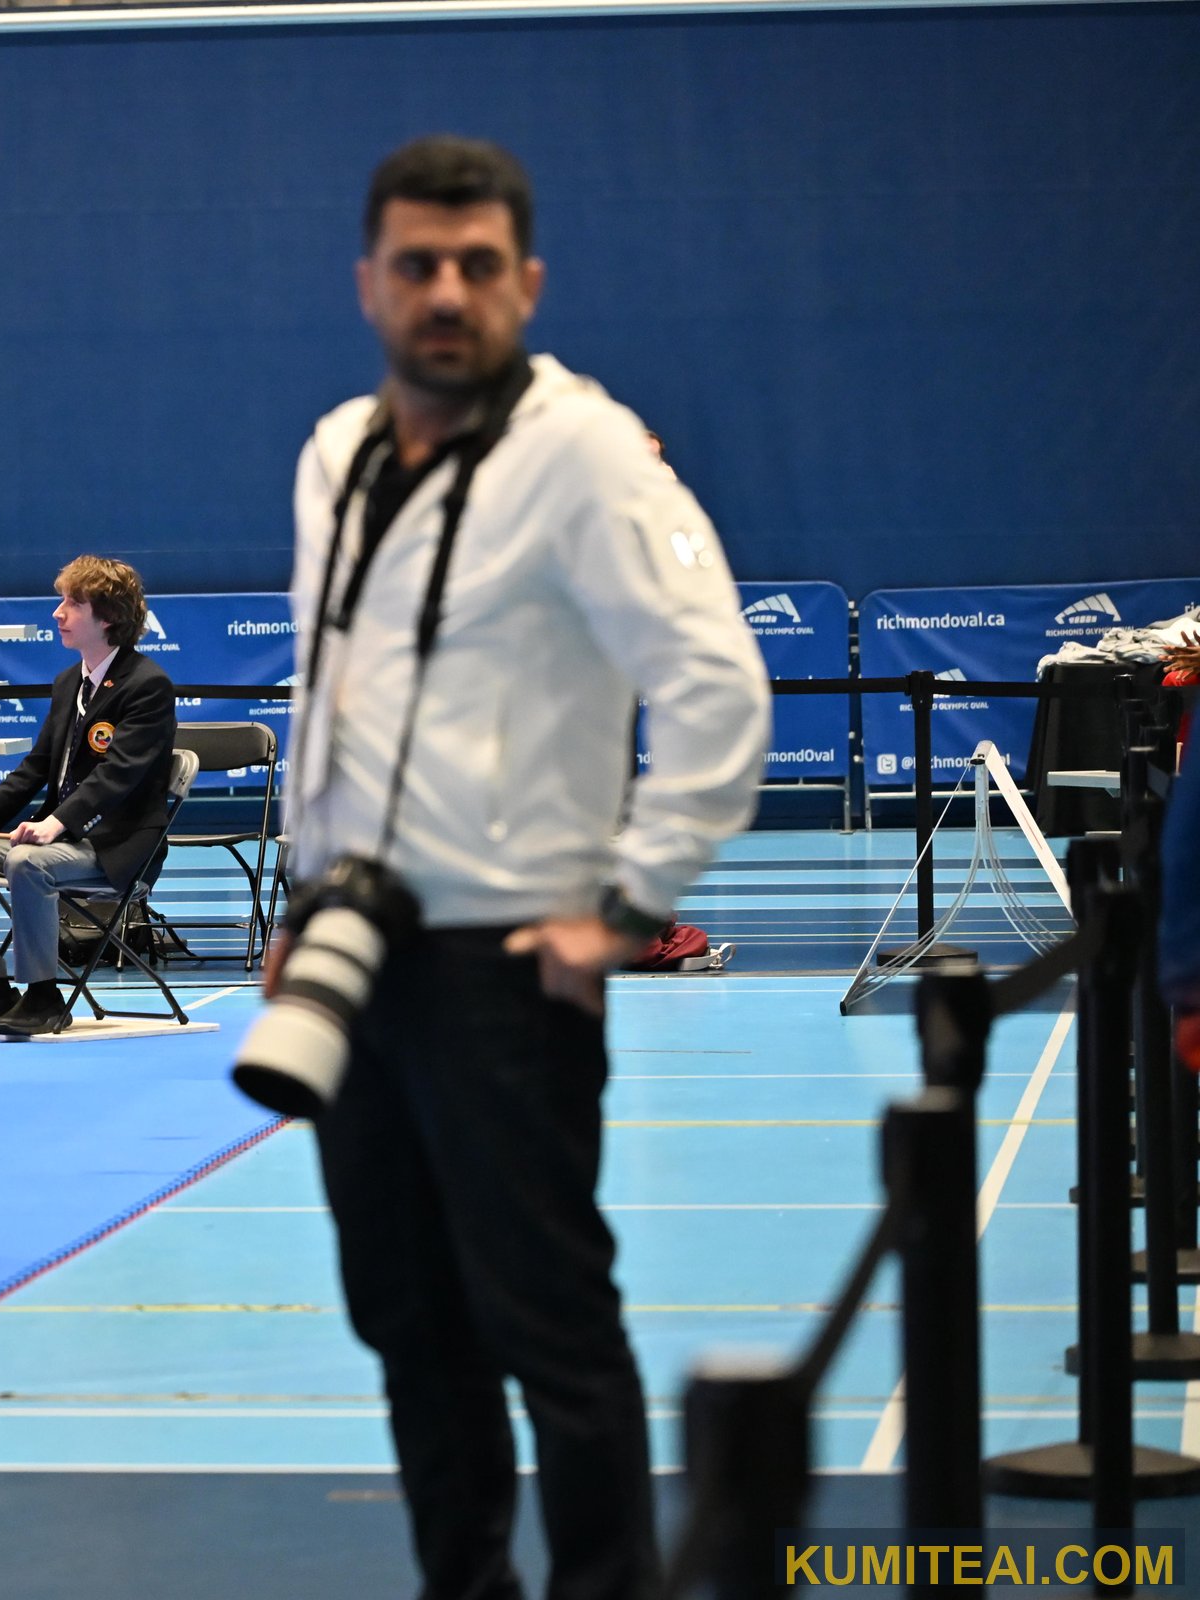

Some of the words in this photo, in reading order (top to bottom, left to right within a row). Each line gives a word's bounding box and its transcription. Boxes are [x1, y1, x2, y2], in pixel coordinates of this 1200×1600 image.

[877, 612, 1005, 630] richmondoval.ca
[765, 627, 795, 635] OLYMPIC
[796, 627, 814, 635] OVAL
[1046, 629, 1084, 637] RICHMOND
[162, 643, 180, 651] OVAL
[939, 702, 969, 710] OLYMPIC
[970, 702, 989, 710] OVAL
[249, 706, 286, 716] RICHMOND
